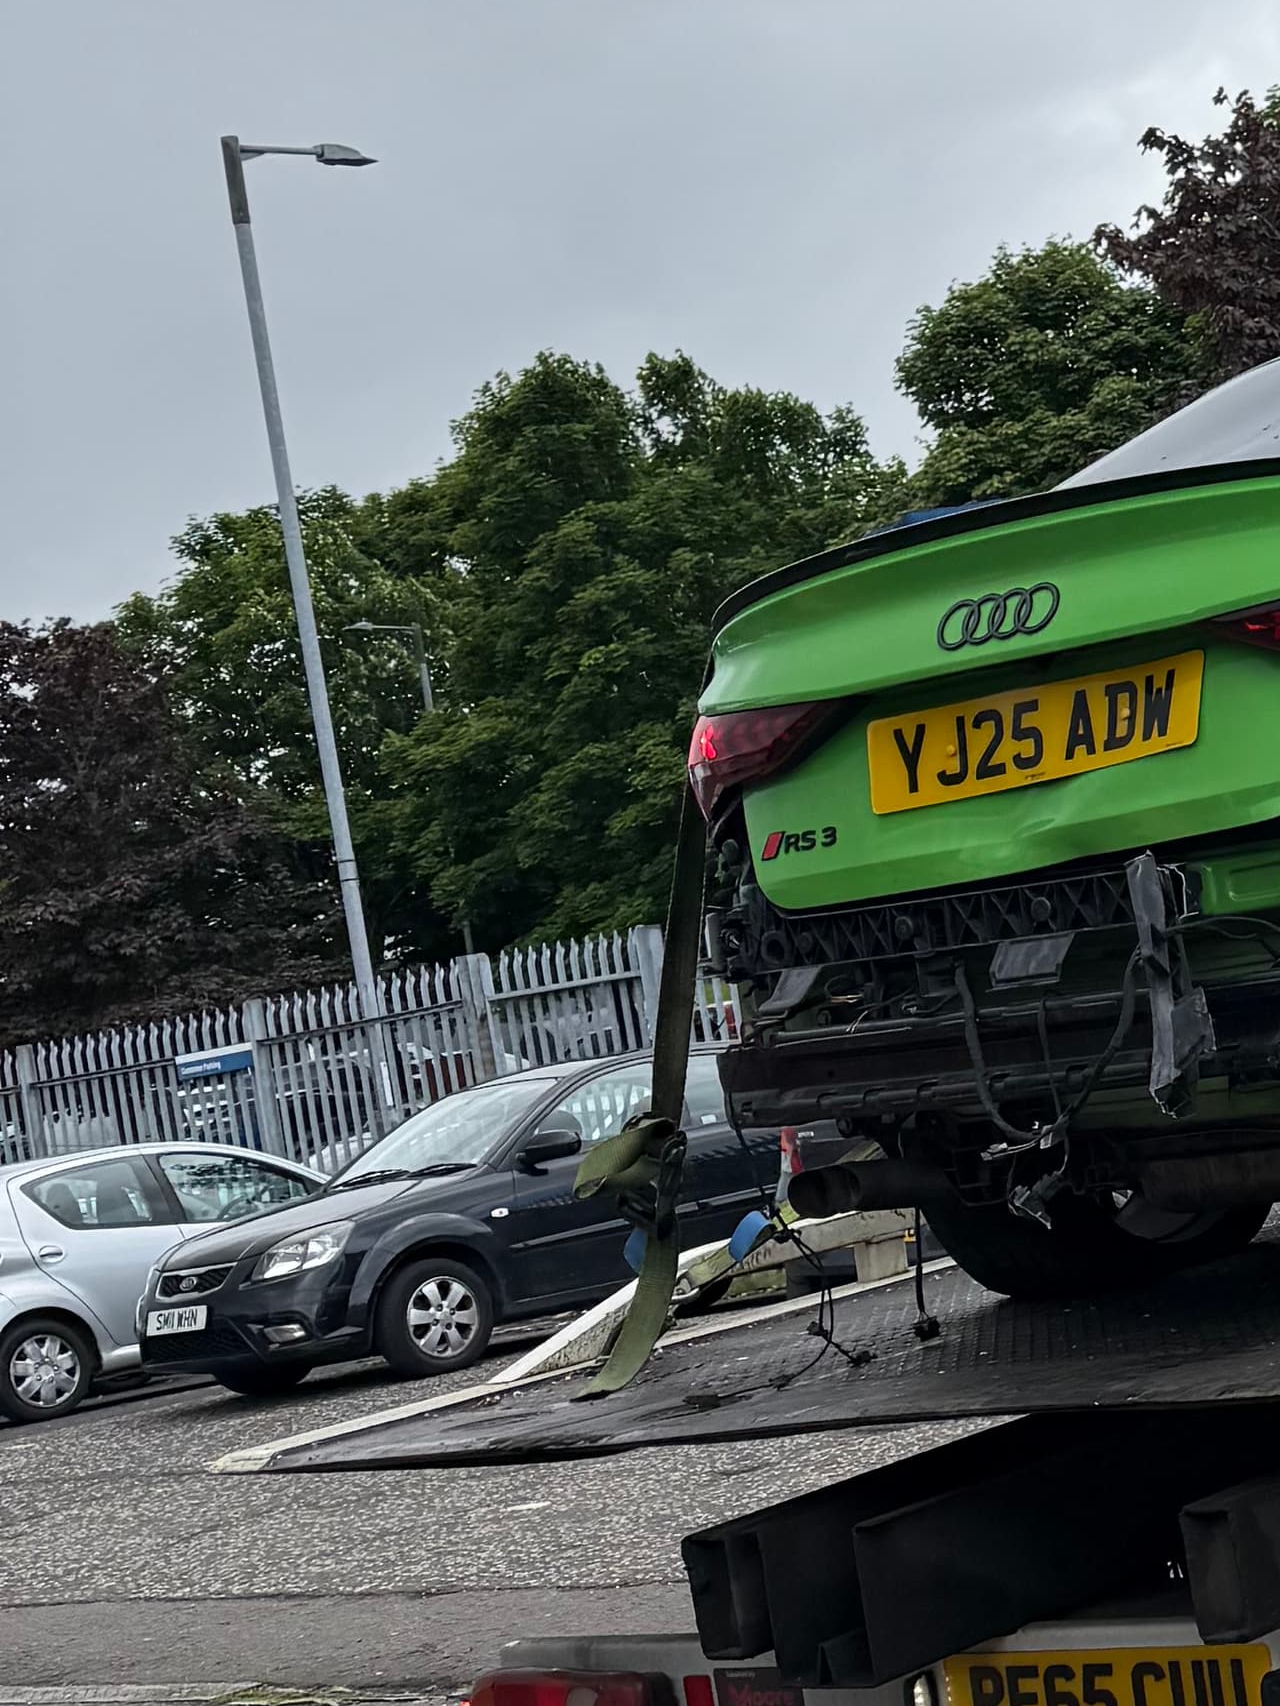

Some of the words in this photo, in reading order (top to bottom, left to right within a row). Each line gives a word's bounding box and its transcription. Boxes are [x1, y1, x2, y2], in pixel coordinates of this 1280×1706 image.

[893, 698, 1044, 794] YJ25
[1064, 668, 1176, 761] ADW
[784, 829, 817, 855] RS
[821, 826, 837, 848] 3
